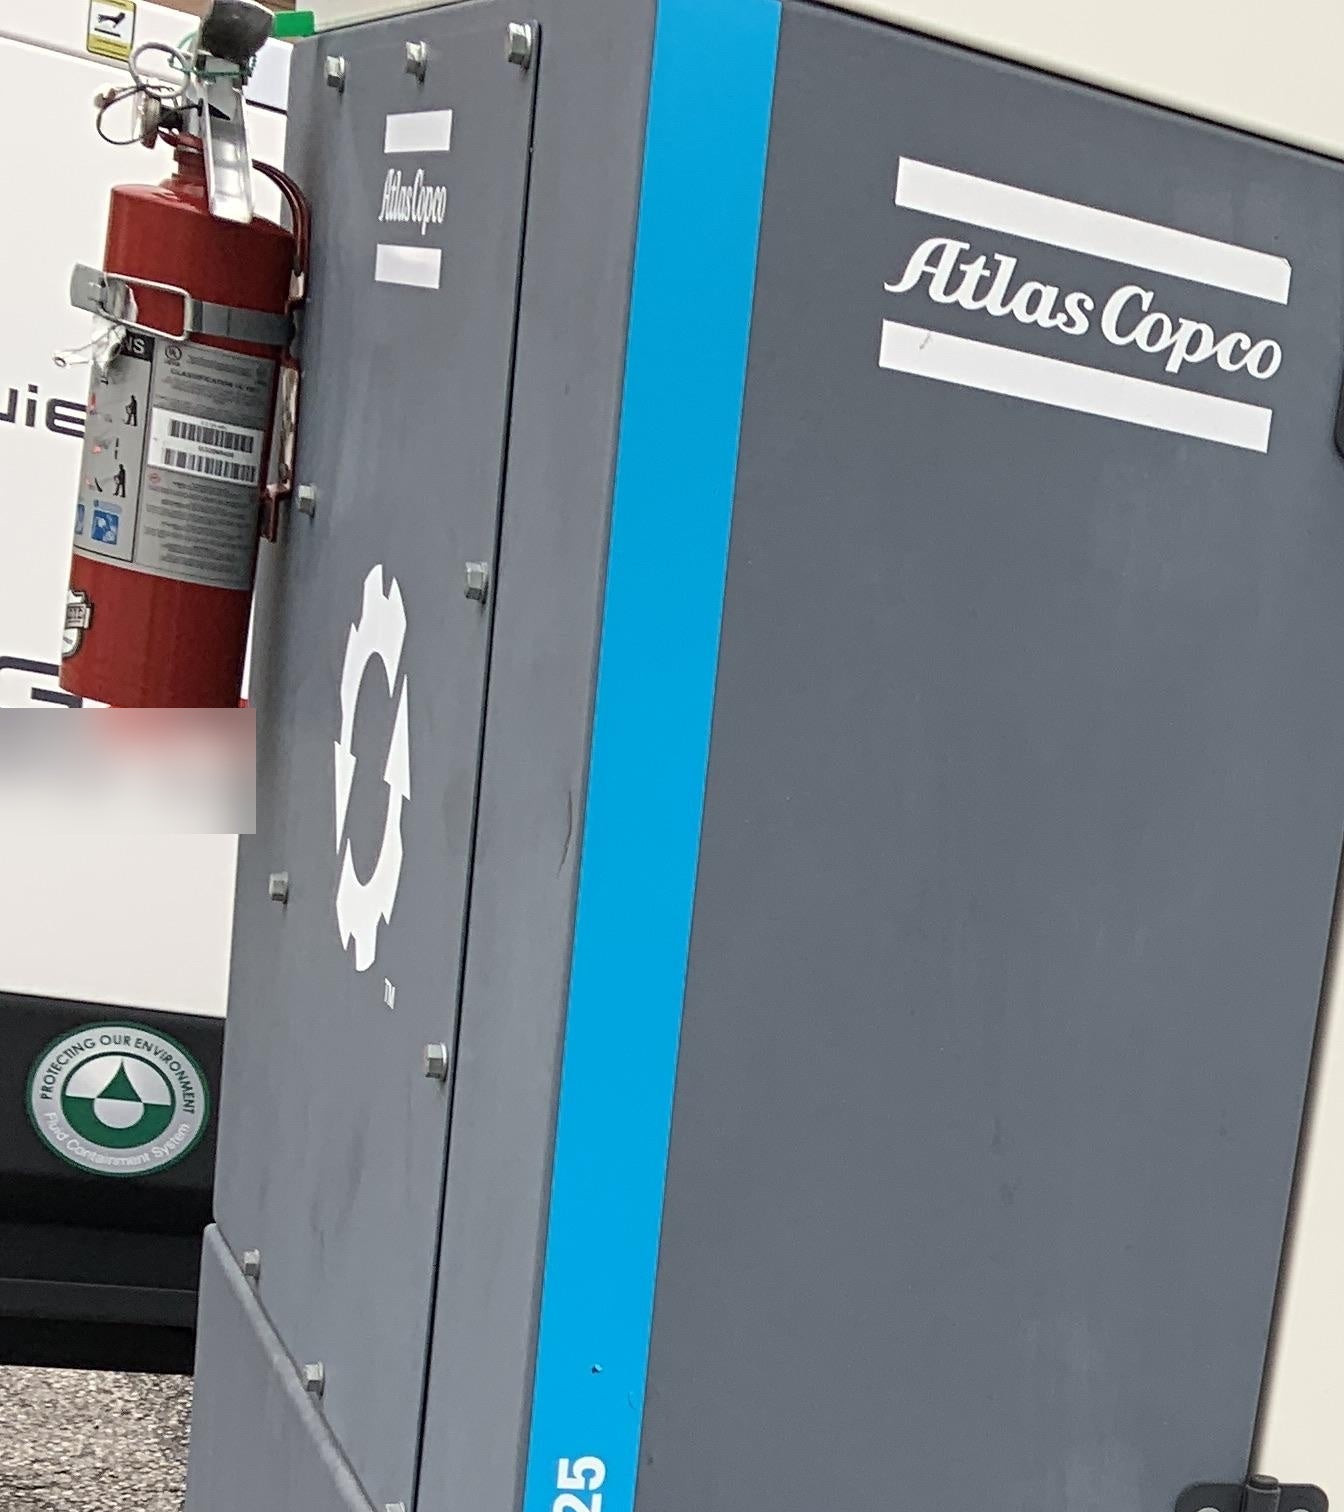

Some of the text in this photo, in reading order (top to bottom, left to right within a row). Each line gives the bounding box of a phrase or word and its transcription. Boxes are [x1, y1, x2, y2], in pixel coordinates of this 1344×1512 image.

[378, 168, 447, 236] Atlas Copco
[883, 237, 1283, 380] Atlas Copco
[40, 1034, 196, 1115] PROTECTING OUR ENVIRONMENT
[44, 1111, 191, 1166] Fluid Containment System
